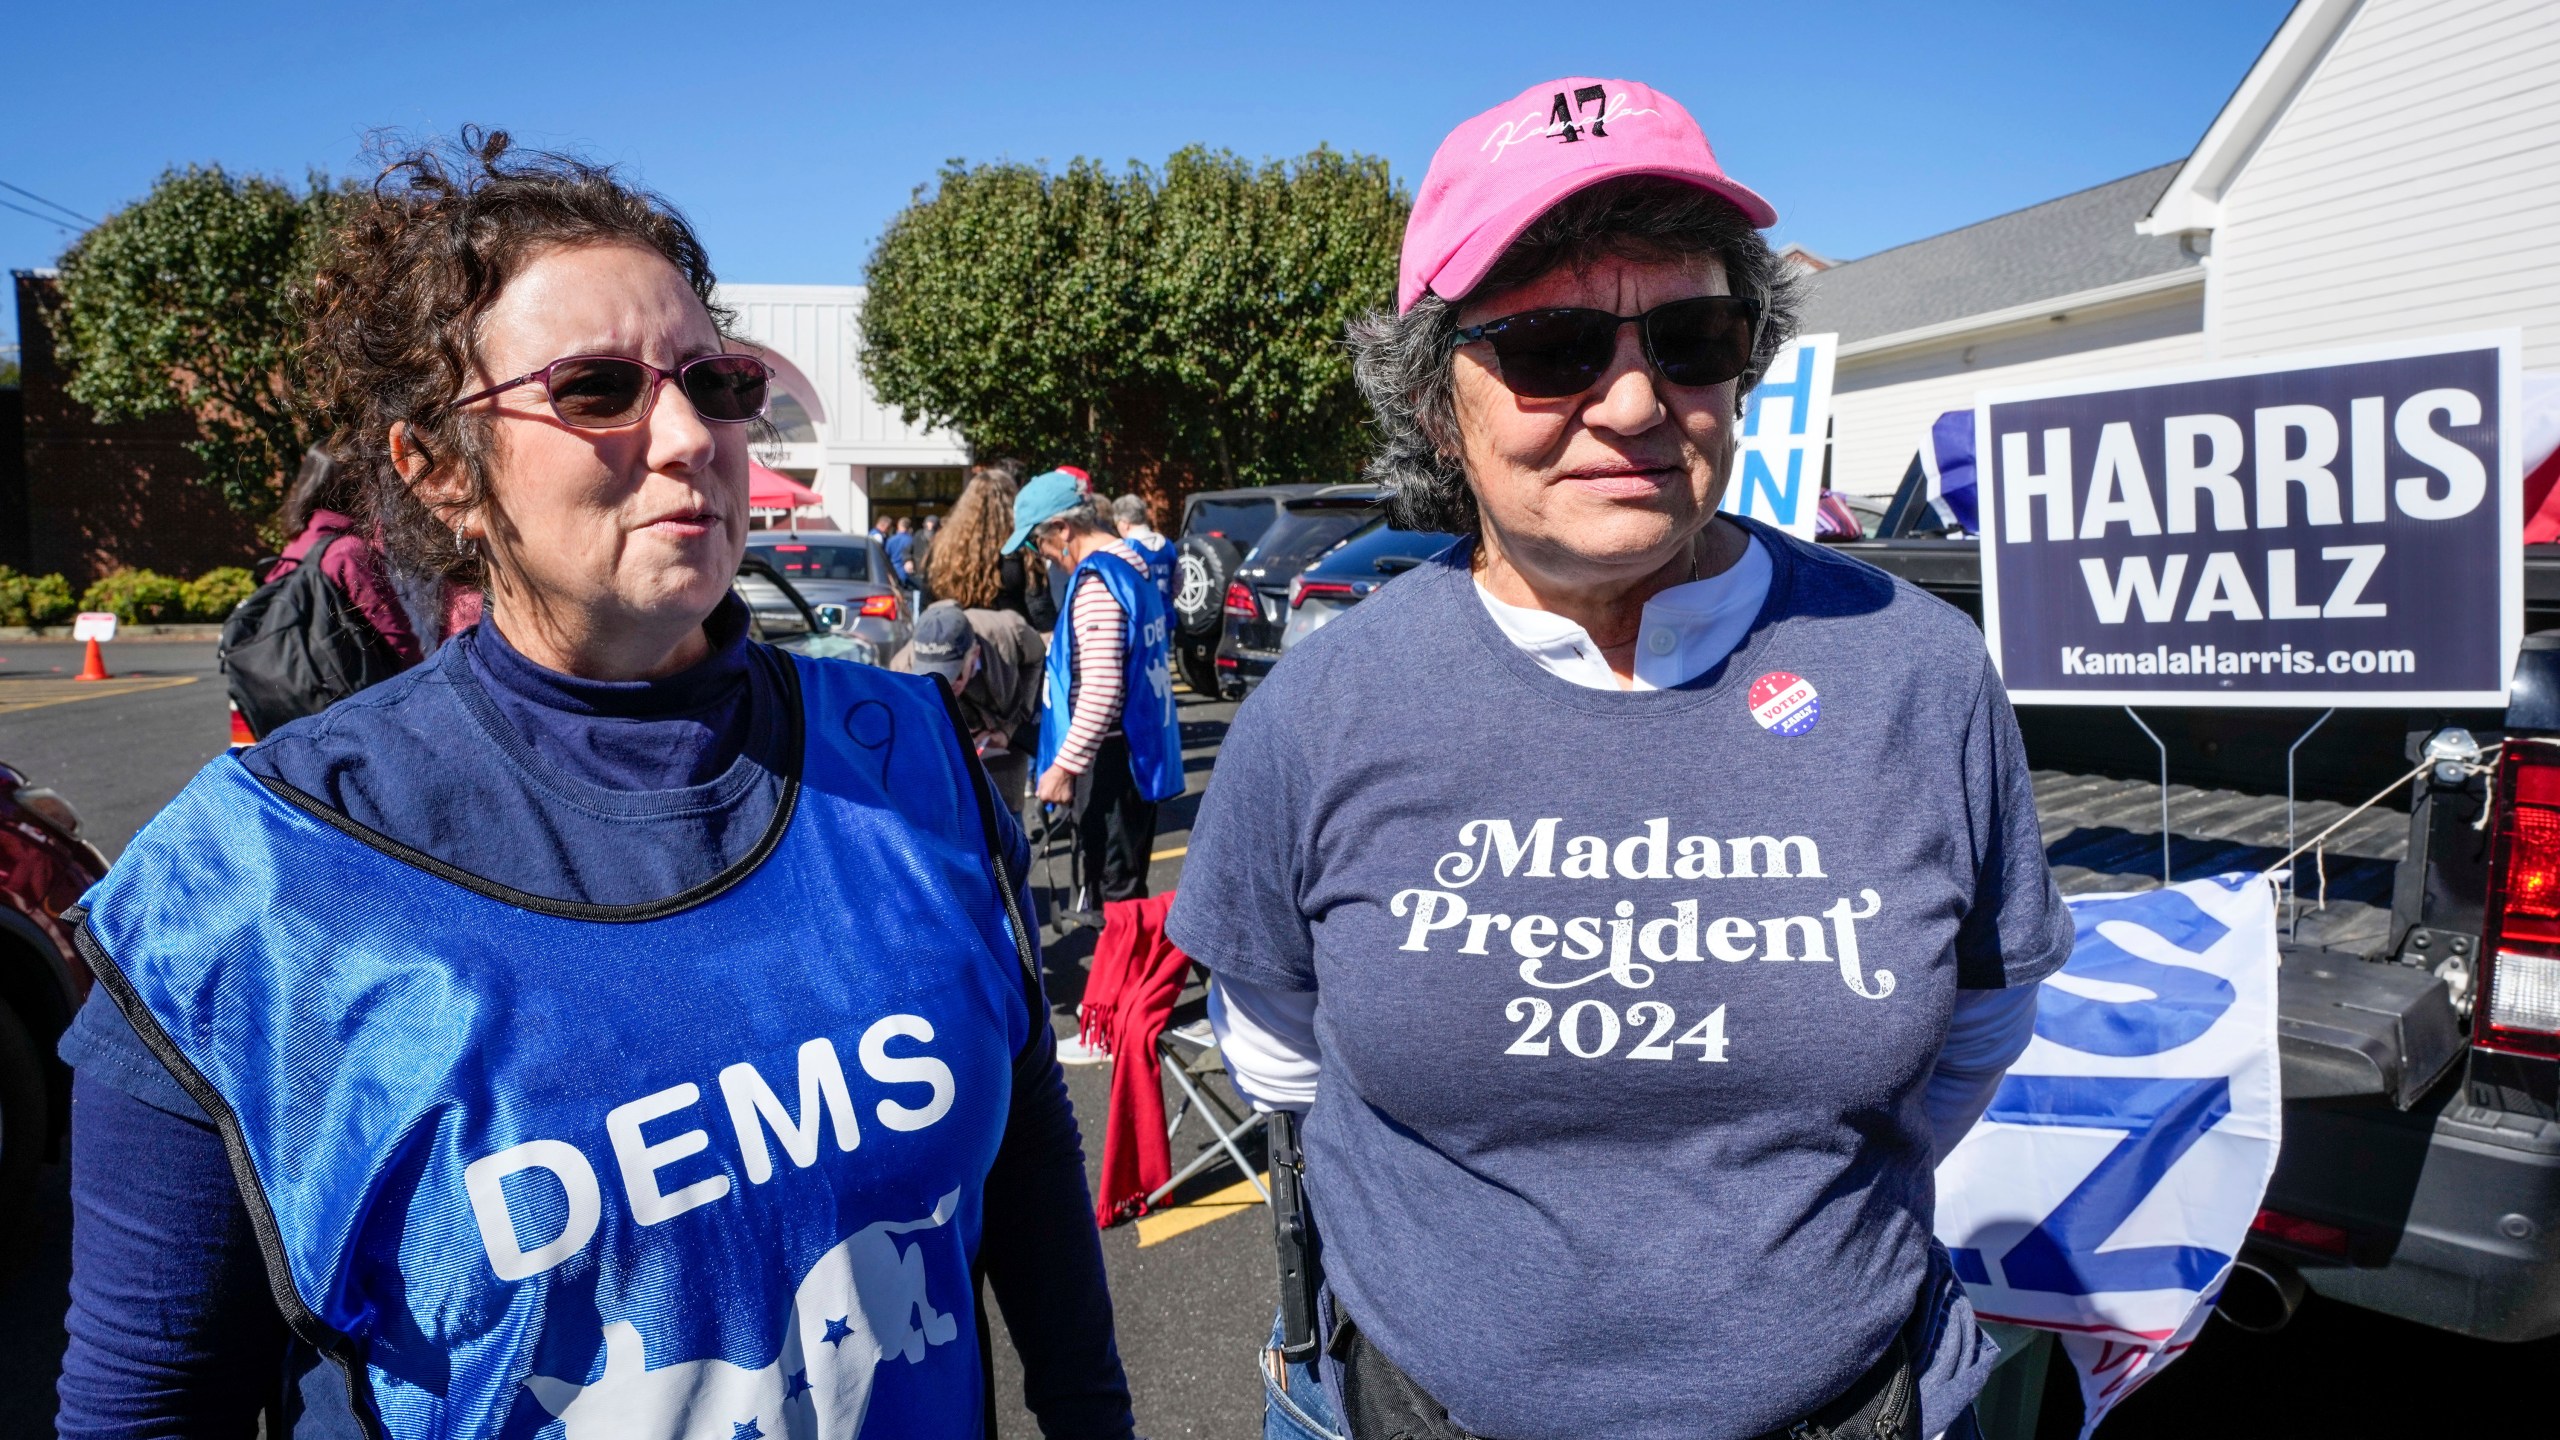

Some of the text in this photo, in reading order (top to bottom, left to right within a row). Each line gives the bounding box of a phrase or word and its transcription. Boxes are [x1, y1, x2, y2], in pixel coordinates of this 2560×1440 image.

[1546, 84, 1609, 144] 47
[2001, 387, 2486, 543] HARRIS
[2079, 544, 2387, 624] WALZ
[1766, 683, 1777, 695] I
[2061, 644, 2416, 675] KamalaHarris.com
[1763, 689, 1806, 719] VOTED
[846, 700, 896, 792] 9
[1434, 817, 1827, 889] Madam
[1390, 888, 1896, 999] President
[1504, 999, 1730, 1063] 2024
[464, 1013, 956, 1281] DEMS
